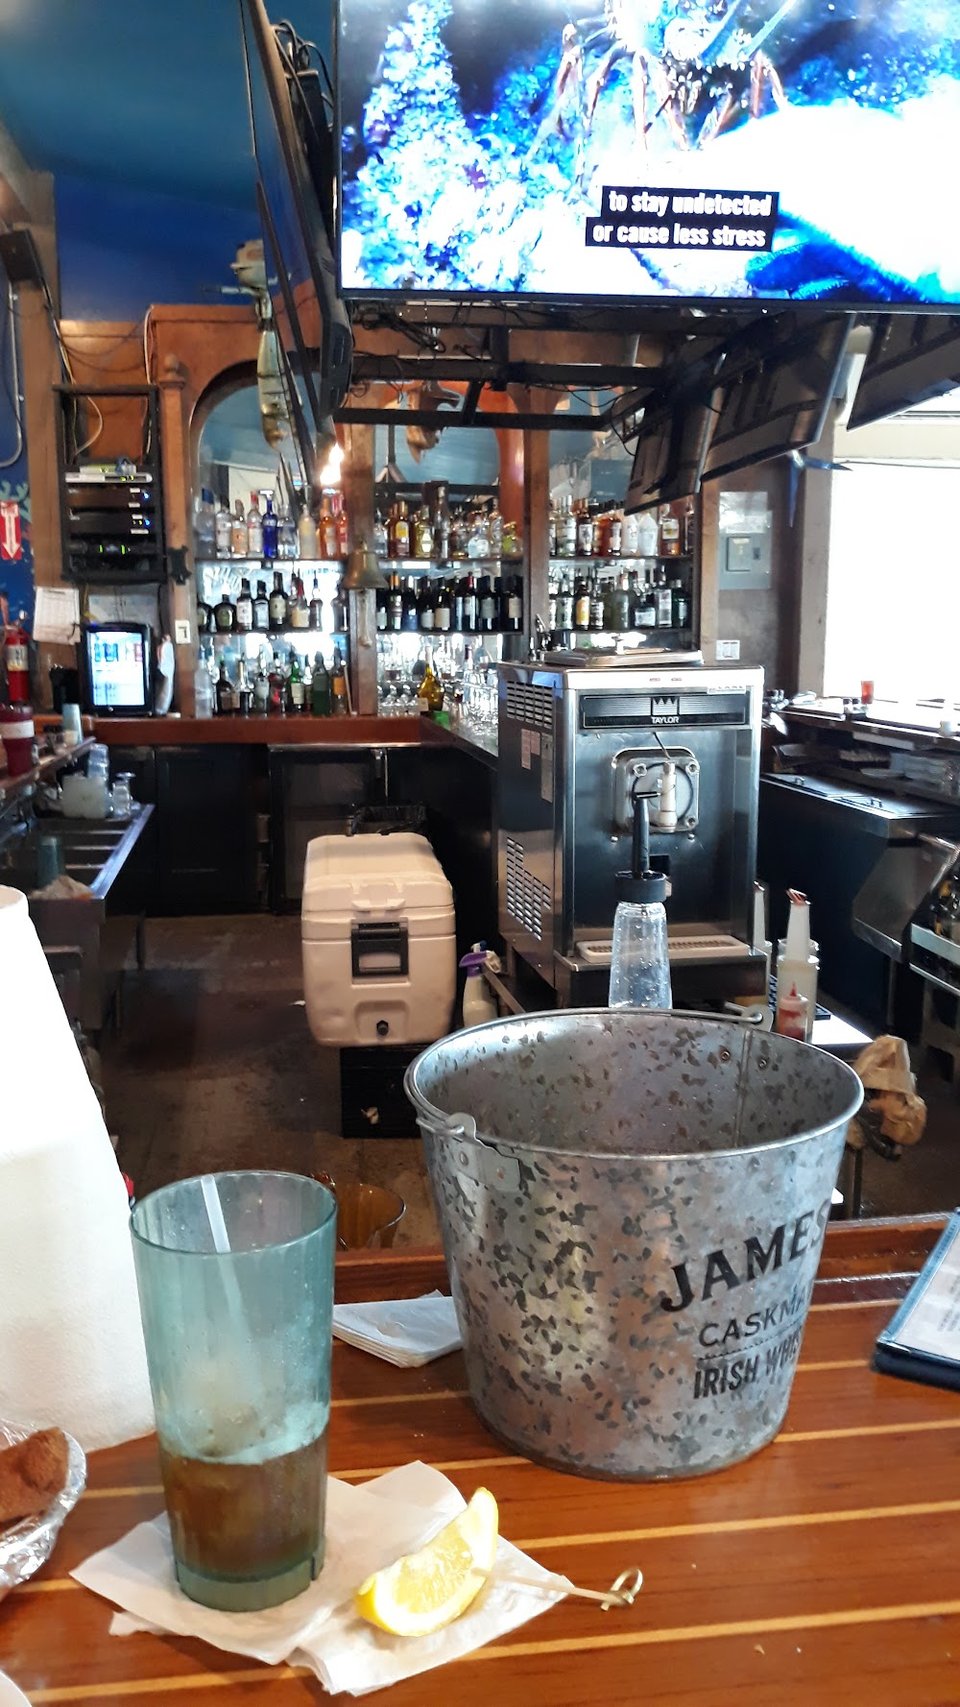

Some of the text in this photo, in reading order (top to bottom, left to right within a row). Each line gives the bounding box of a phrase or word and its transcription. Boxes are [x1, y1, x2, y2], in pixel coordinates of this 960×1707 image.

[609, 190, 772, 217] to stay undetected
[592, 223, 767, 248] or cause less stress
[651, 716, 679, 724] TAYLOR
[692, 1353, 760, 1400] IRISH
